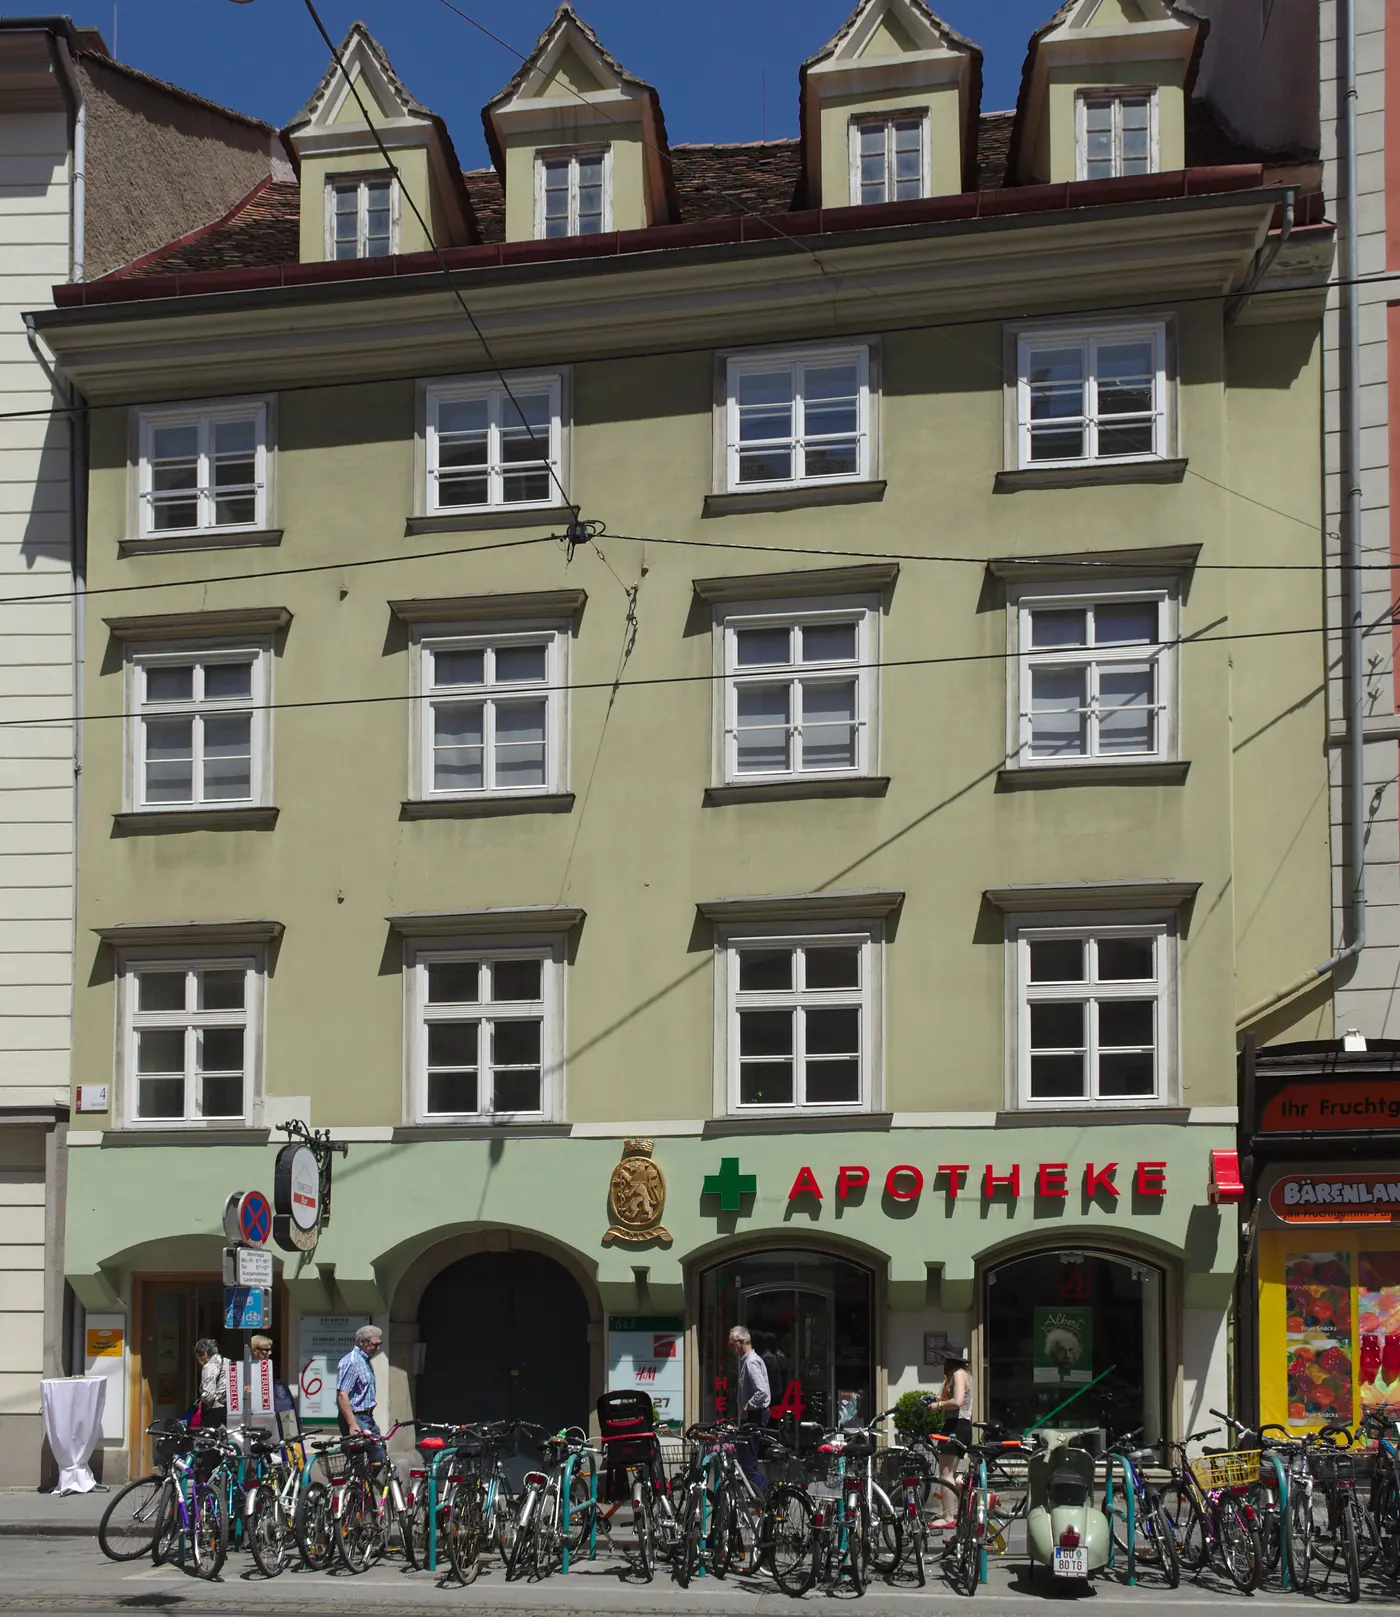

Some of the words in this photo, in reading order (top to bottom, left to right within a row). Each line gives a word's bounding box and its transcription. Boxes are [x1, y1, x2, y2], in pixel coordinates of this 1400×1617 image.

[99, 1087, 107, 1100] 4
[1281, 1101, 1308, 1117] Ihr
[788, 1161, 1167, 1200] APOTHEKE
[1044, 1312, 1086, 1331] Albert
[635, 1366, 657, 1382] H&M
[1318, 1411, 1339, 1419] Snacks
[1058, 1559, 1070, 1570] 80
